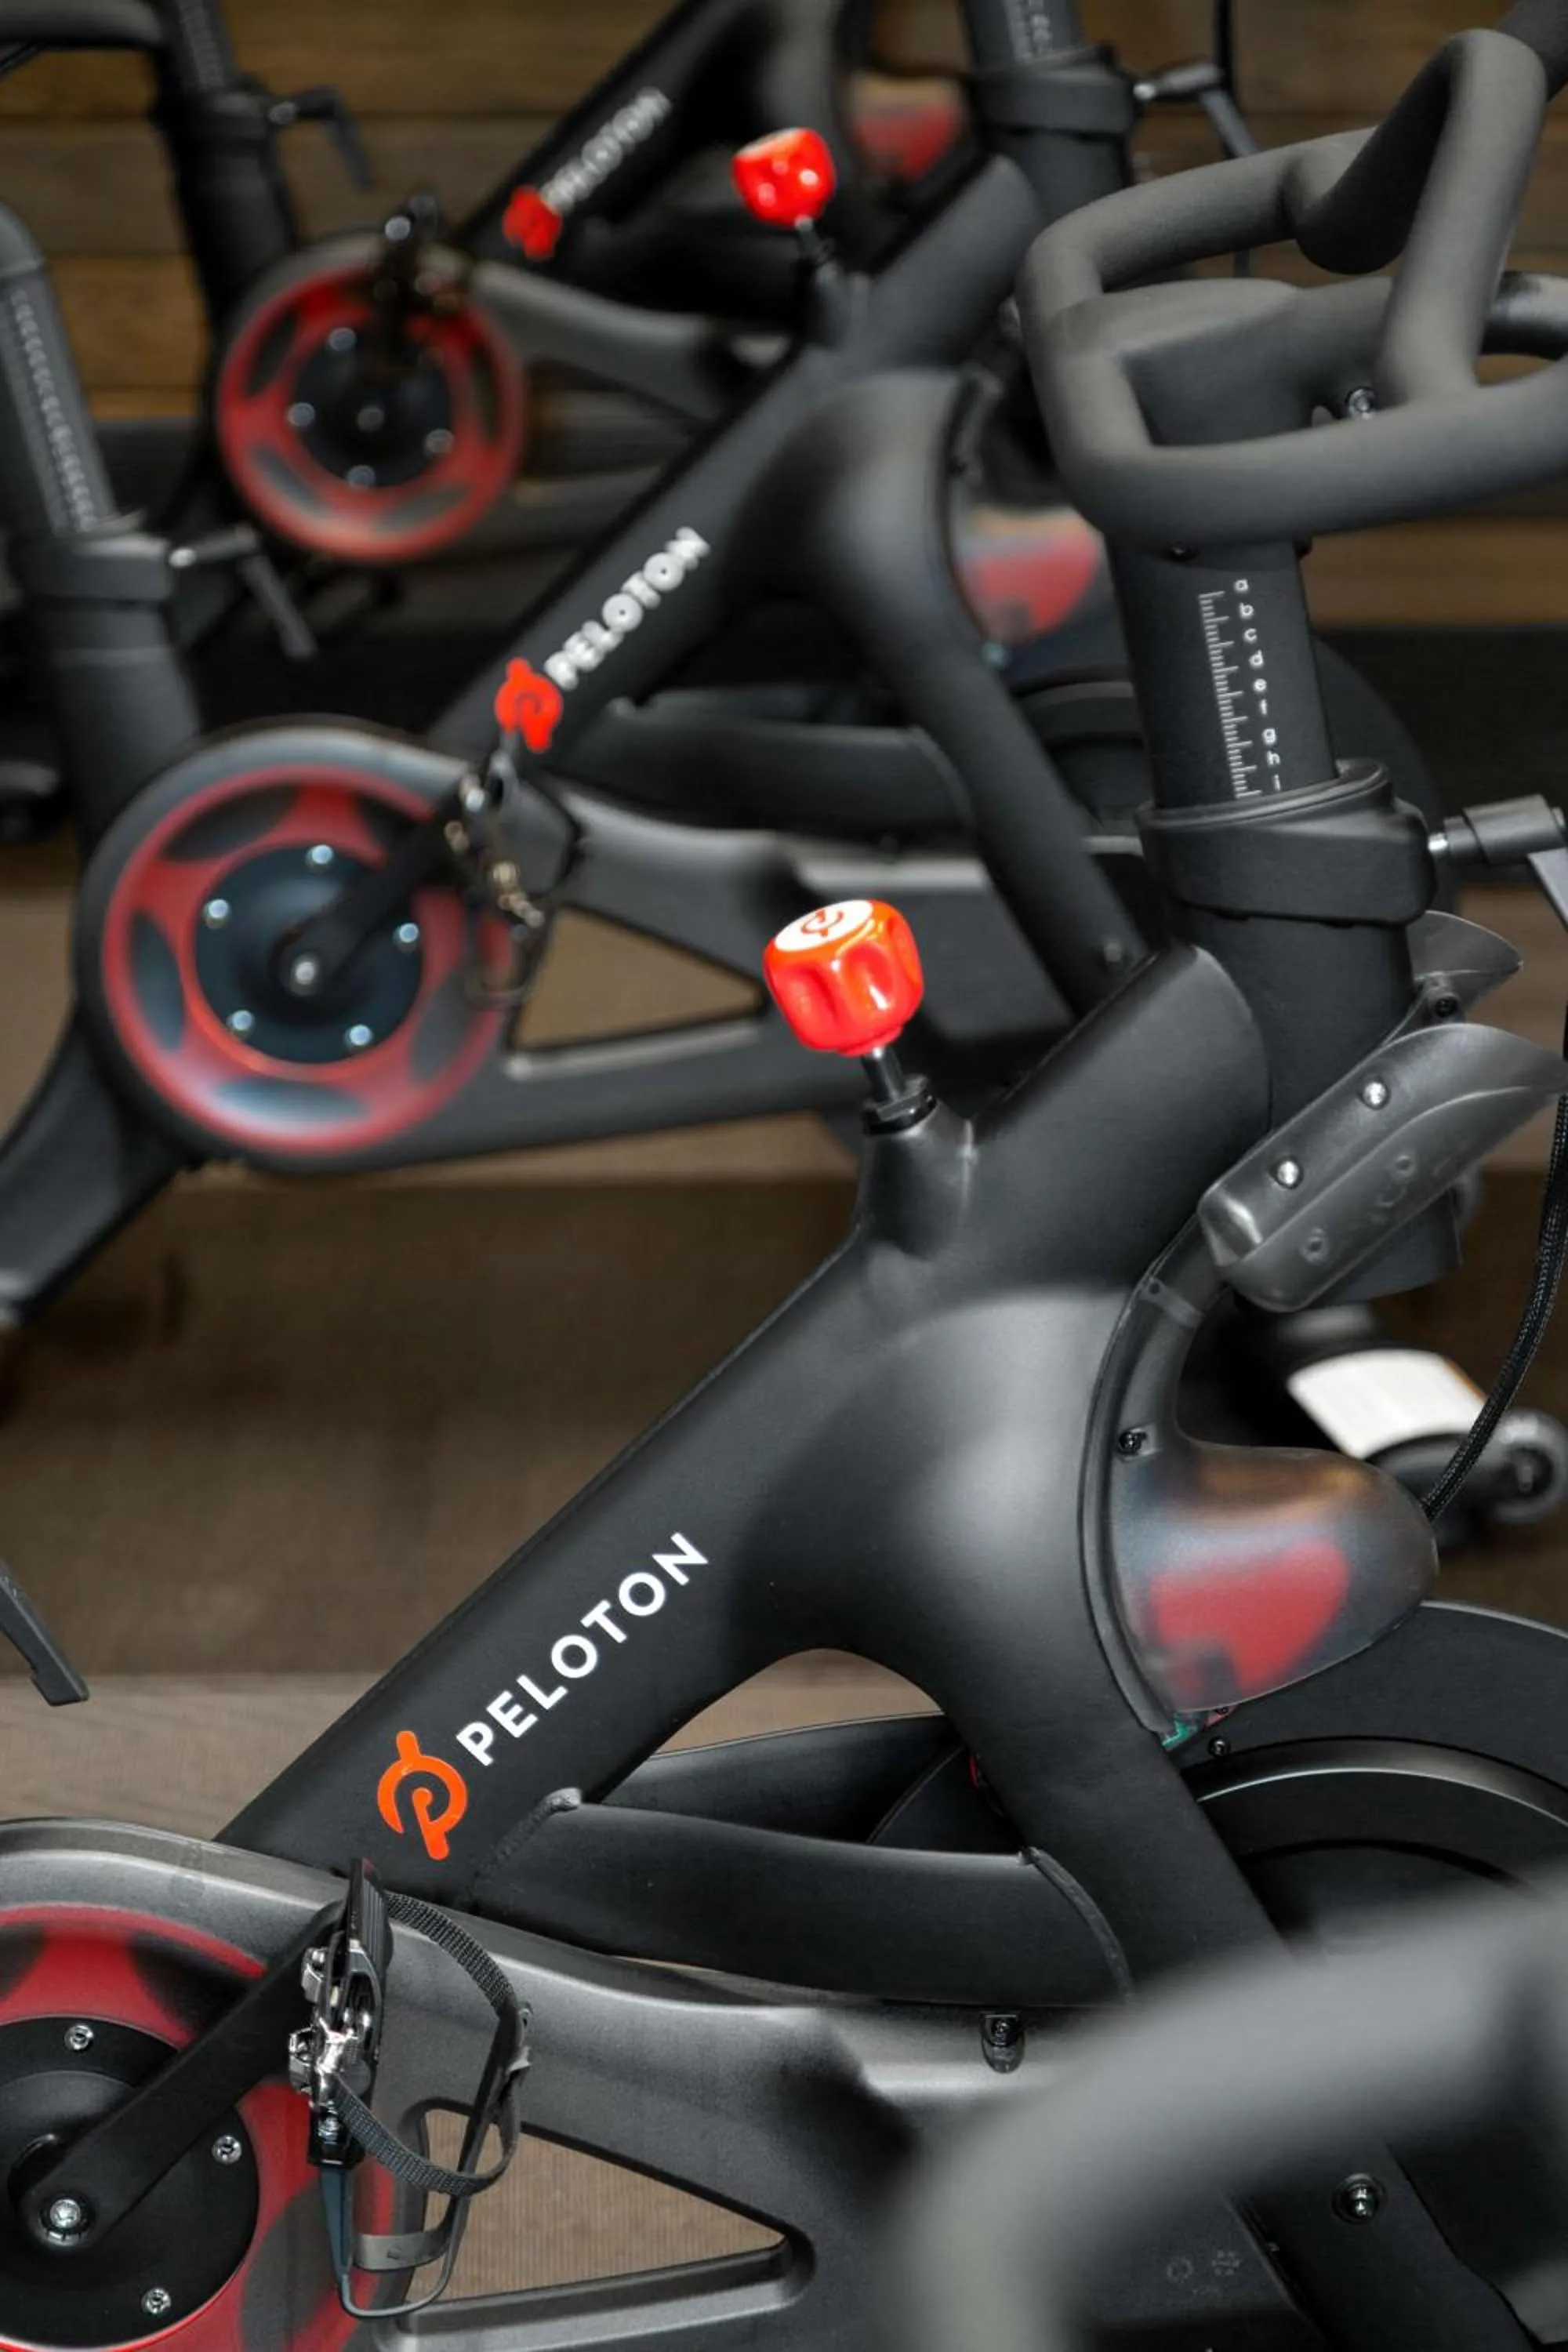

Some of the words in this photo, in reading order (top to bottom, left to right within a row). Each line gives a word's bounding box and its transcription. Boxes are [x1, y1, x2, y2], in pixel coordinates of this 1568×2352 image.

[544, 526, 710, 690] PELOTON
[1239, 602, 1254, 619] b
[1243, 627, 1258, 643] c
[1248, 649, 1265, 669] d
[1252, 678, 1268, 694] e
[453, 1532, 709, 1766] PELOTON
